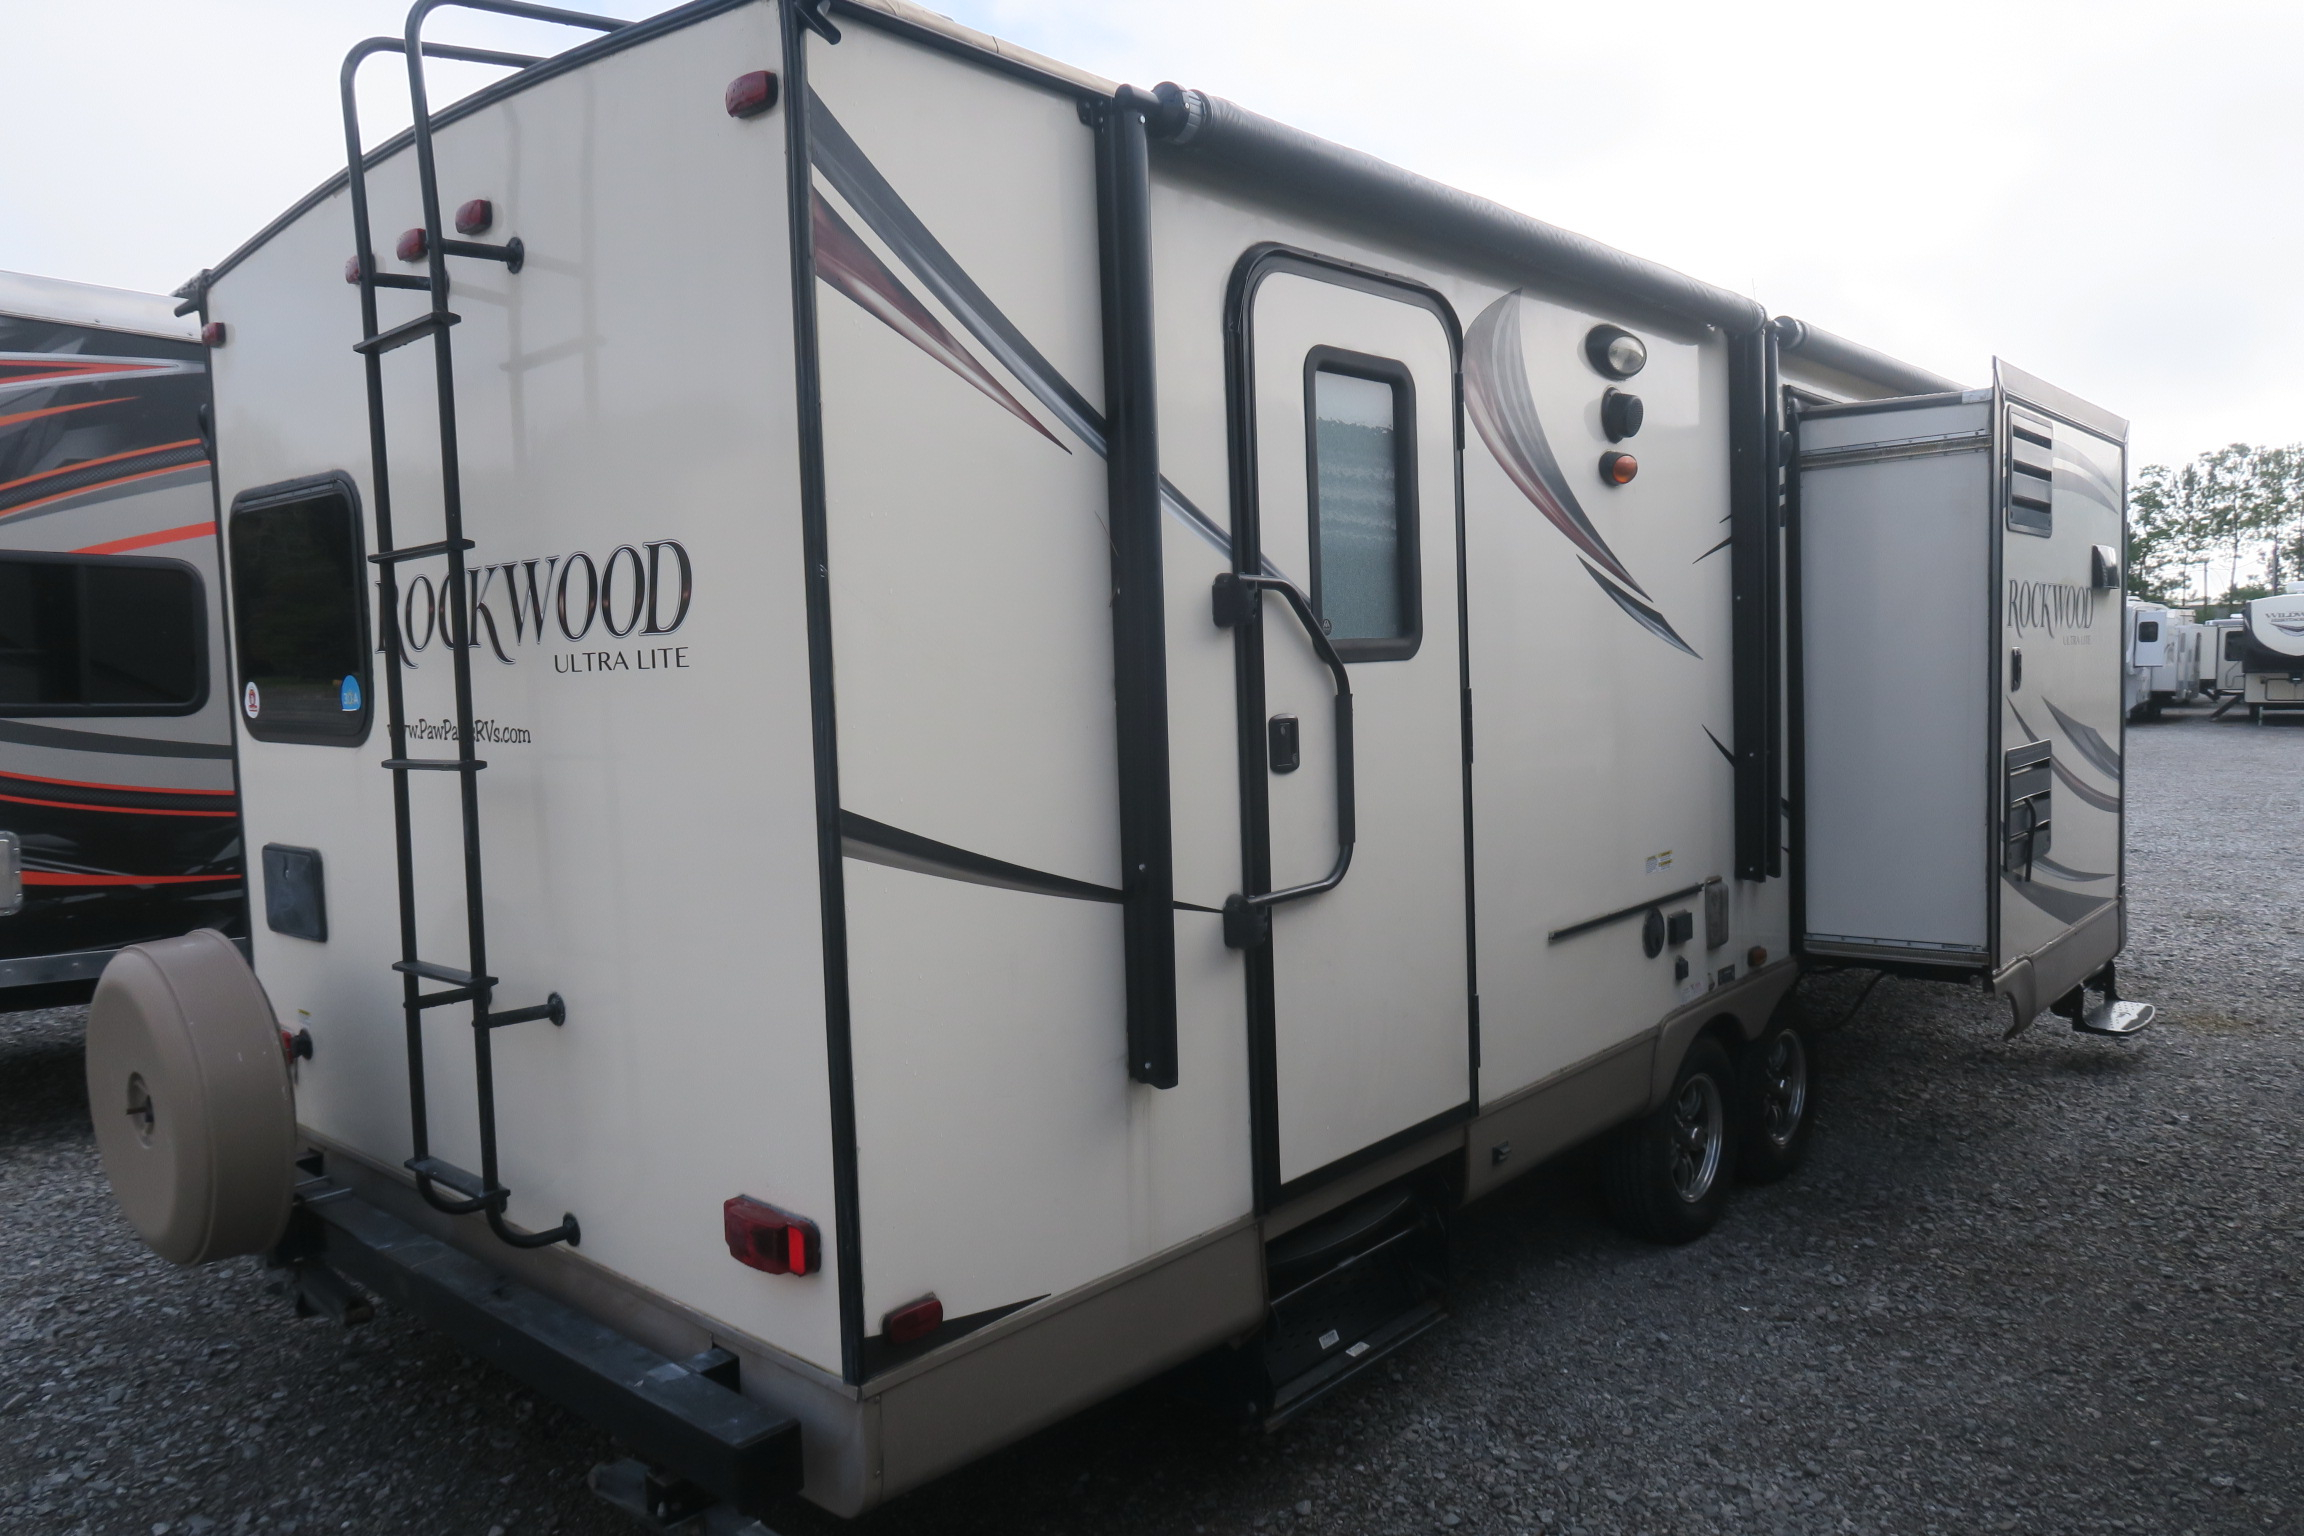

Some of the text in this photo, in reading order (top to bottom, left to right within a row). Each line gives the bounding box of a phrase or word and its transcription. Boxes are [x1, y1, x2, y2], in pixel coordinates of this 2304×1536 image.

[2007, 579, 2094, 639] ROCKWOOD
[554, 646, 690, 674] ULTRA LITE
[387, 718, 532, 744] w.PawPaRVs.com
